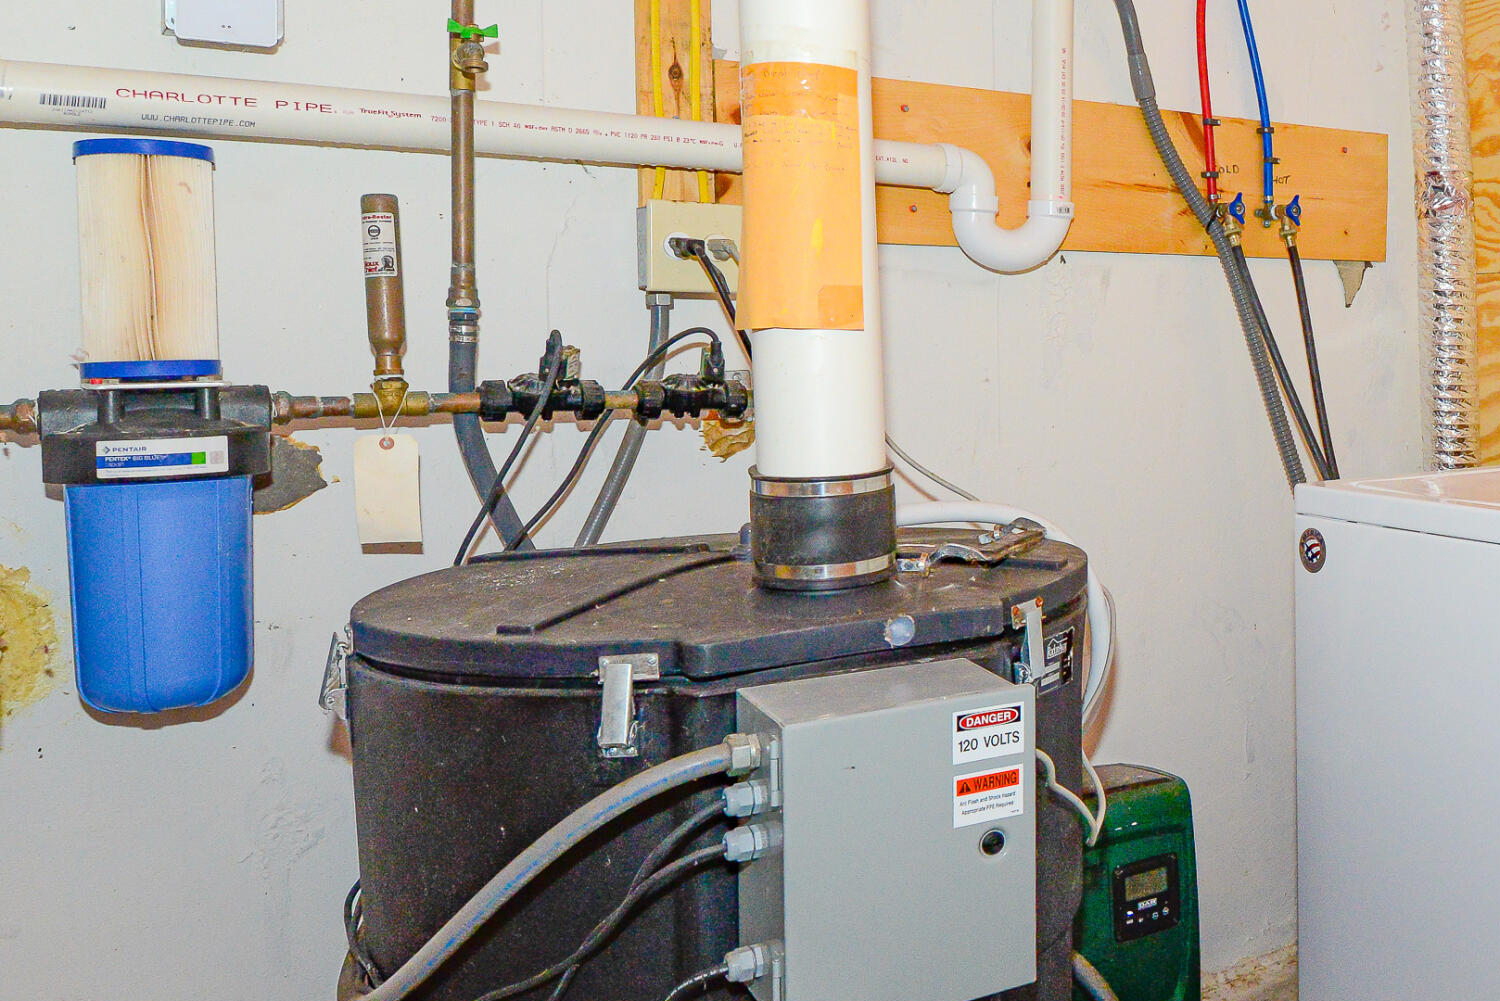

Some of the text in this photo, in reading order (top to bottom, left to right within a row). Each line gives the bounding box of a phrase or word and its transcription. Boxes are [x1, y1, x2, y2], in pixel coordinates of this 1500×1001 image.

[115, 87, 258, 108] CHARLOTTE
[275, 99, 333, 114] PIPE
[1218, 164, 1240, 174] OLD
[965, 711, 1012, 728] DANGER
[958, 730, 1020, 753] 120 VOLTS
[973, 771, 1017, 791] WARNING
